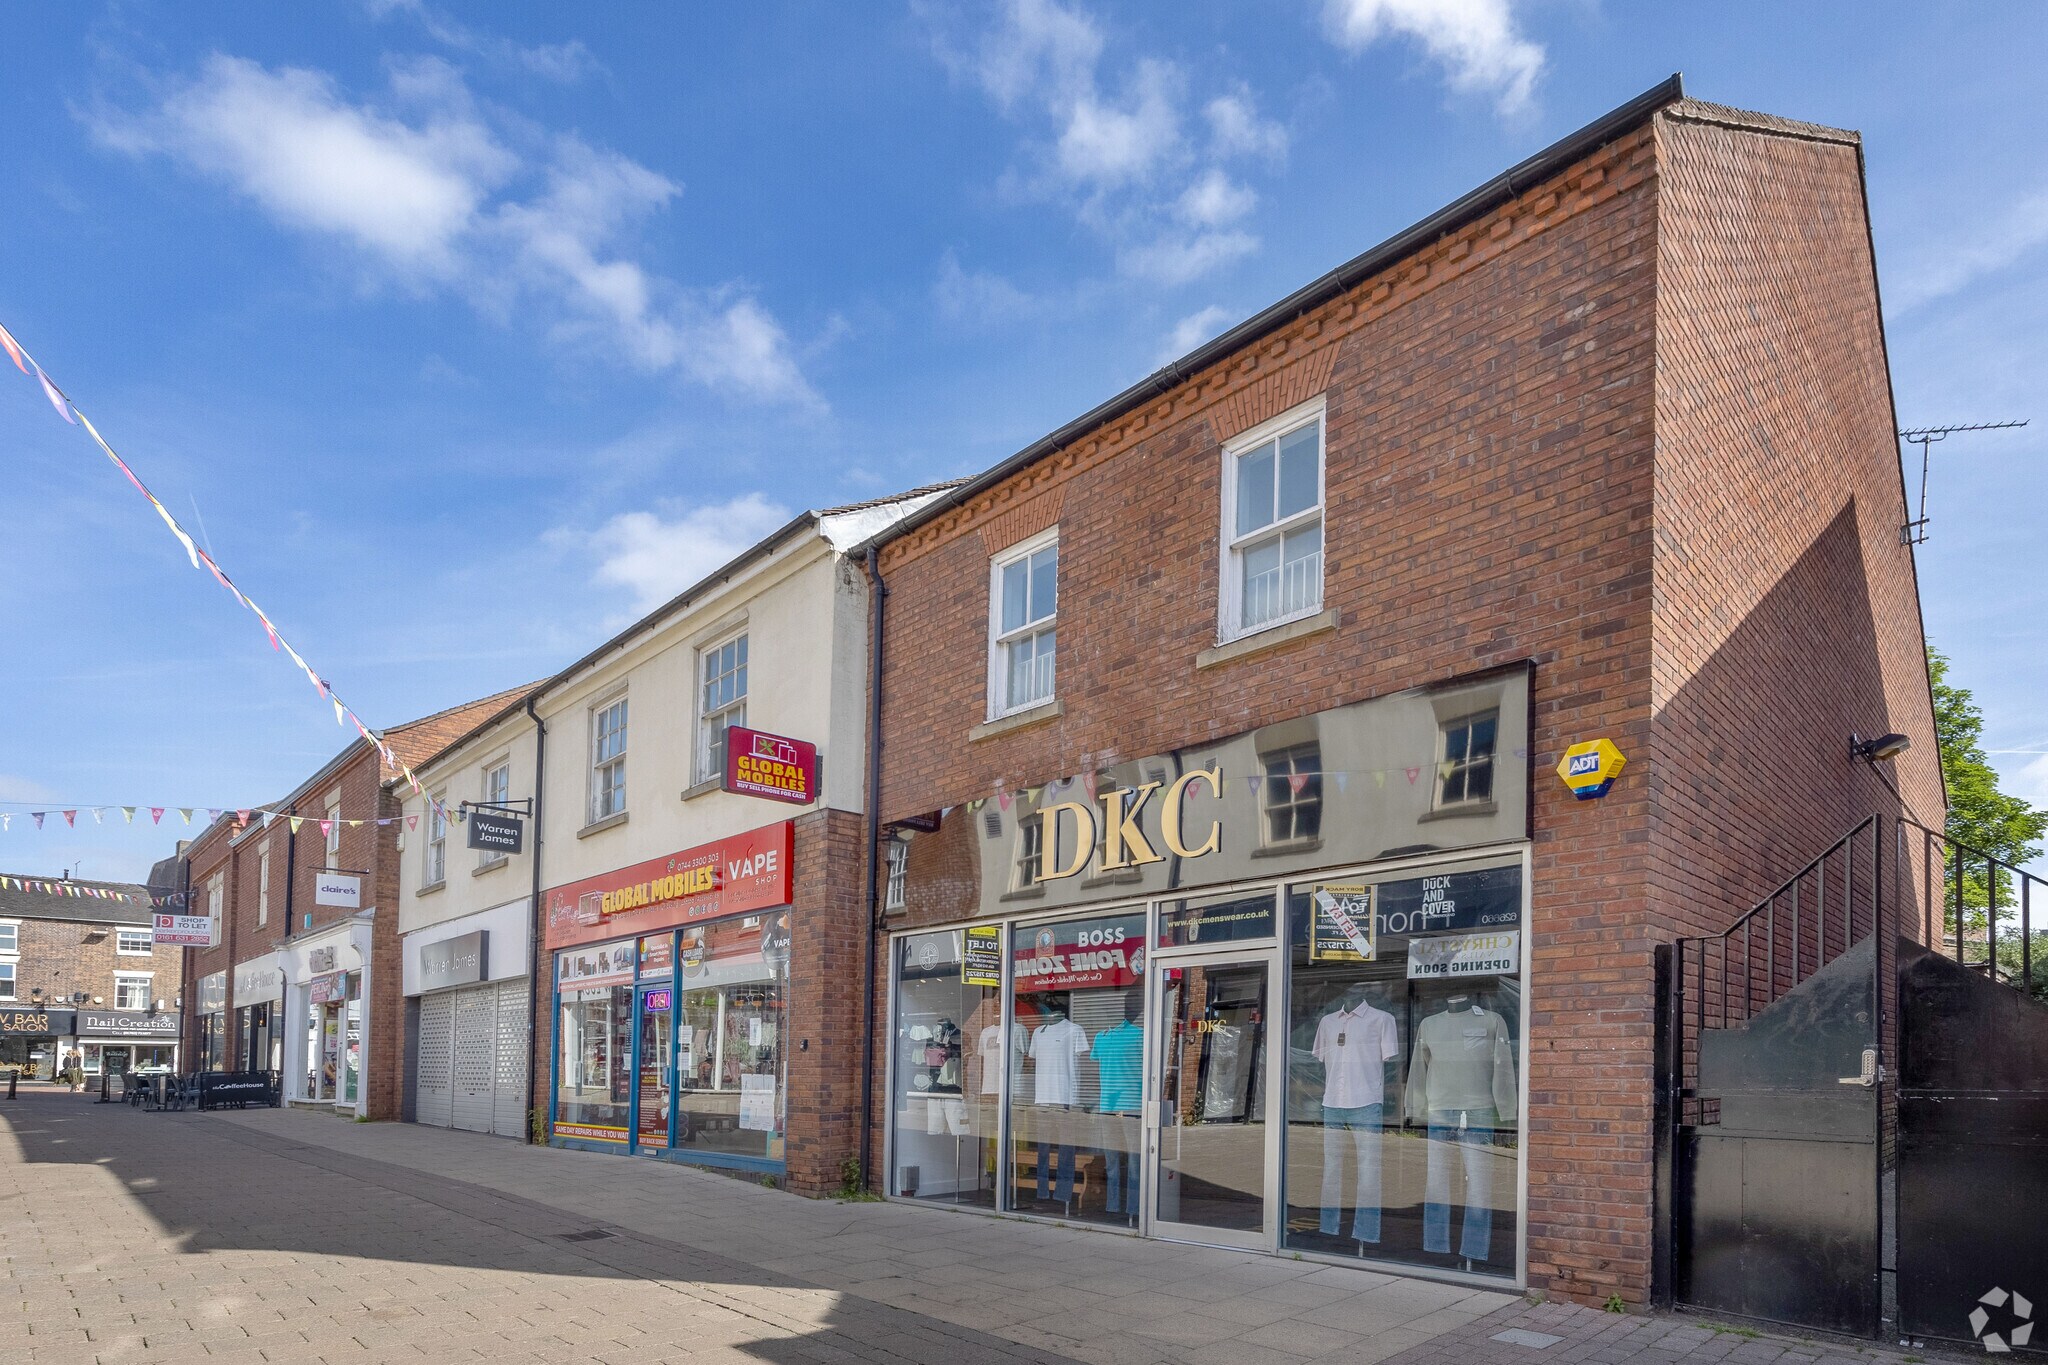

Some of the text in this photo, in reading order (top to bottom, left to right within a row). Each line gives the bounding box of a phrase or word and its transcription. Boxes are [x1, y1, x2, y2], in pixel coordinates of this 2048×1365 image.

[738, 756, 805, 780] GLOBAL
[1570, 755, 1599, 773] ADT
[737, 769, 805, 792] MOBILES
[749, 784, 760, 792] SELL
[761, 787, 780, 795] PHONE
[477, 821, 518, 836] Warren
[1034, 766, 1223, 882] DKC
[479, 832, 515, 845] James
[677, 852, 719, 871] 0744 3300 303
[728, 849, 778, 881] VAPE
[755, 874, 778, 885] SHOP
[321, 885, 356, 895] claire's
[601, 882, 649, 914] GLOBAL
[649, 865, 714, 902] MOBILES
[1423, 889, 1445, 903] AND
[1421, 900, 1456, 915] COVER
[1167, 909, 1270, 927] www.dkcmenswear.co.uk
[1077, 927, 1125, 948] BOSS
[648, 993, 669, 1008] OPEN
[14, 1013, 49, 1025] BAR
[86, 1016, 176, 1028] Nail Creation
[1196, 1020, 1227, 1033] DKC
[3, 1023, 49, 1032] SALON
[555, 1125, 629, 1139] SAME DAY REPAIRS WHILE YOU WAIT
